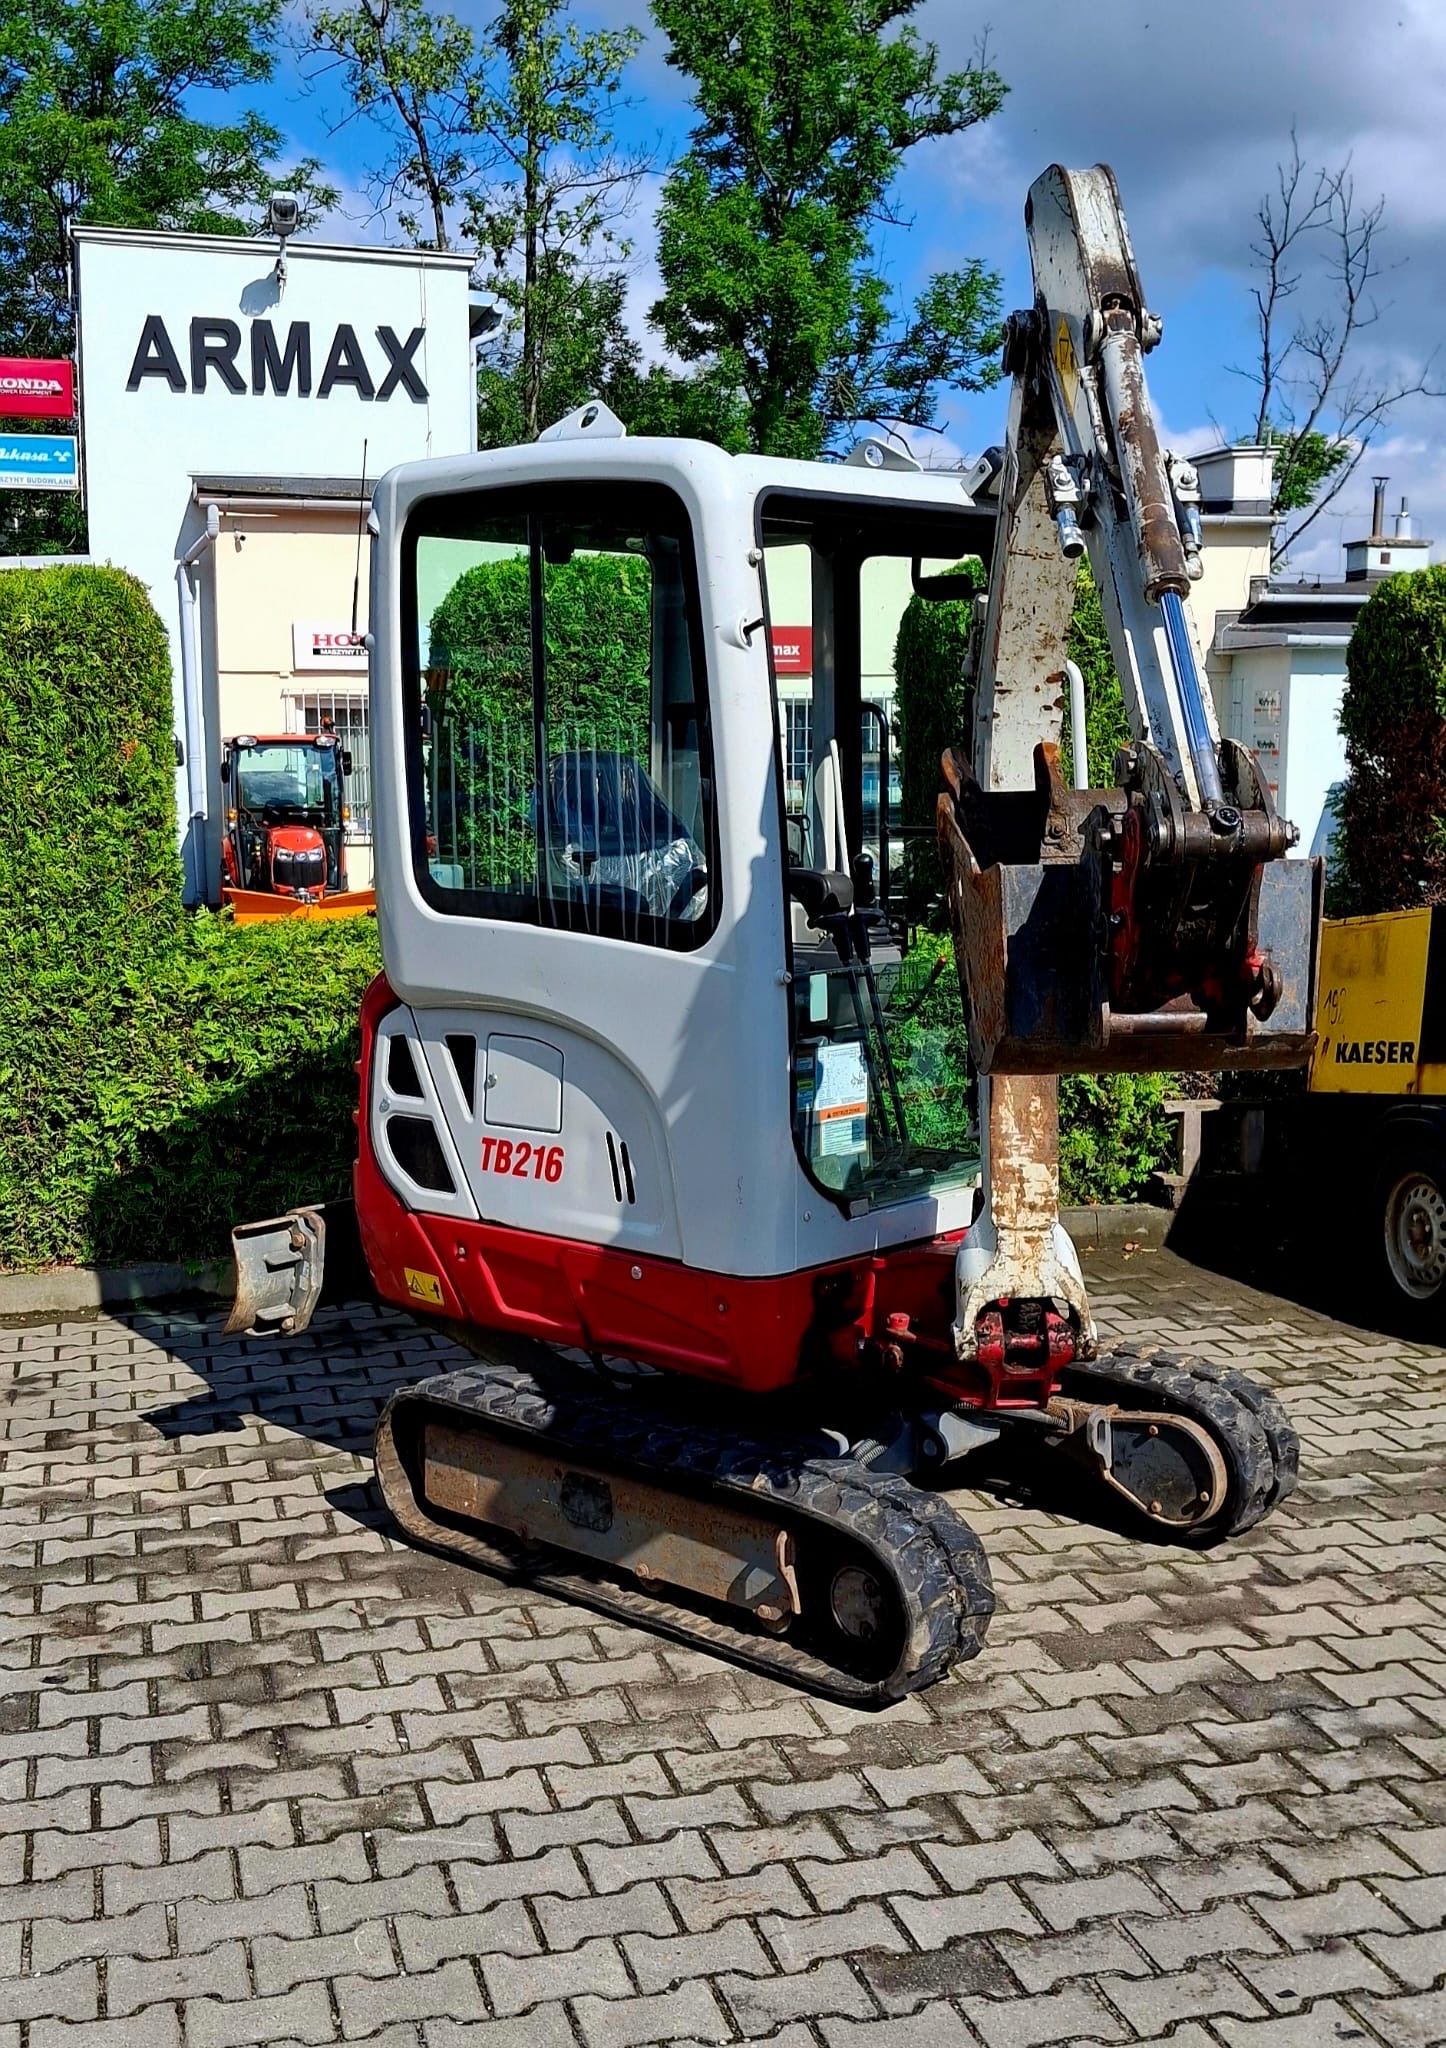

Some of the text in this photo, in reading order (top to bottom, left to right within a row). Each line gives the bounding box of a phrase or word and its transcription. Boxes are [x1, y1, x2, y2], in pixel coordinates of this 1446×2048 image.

[127, 314, 429, 401] ARMAX
[0, 378, 63, 391] ONDA
[1335, 1041, 1415, 1064] KAESER
[481, 1137, 564, 1183] TB216
